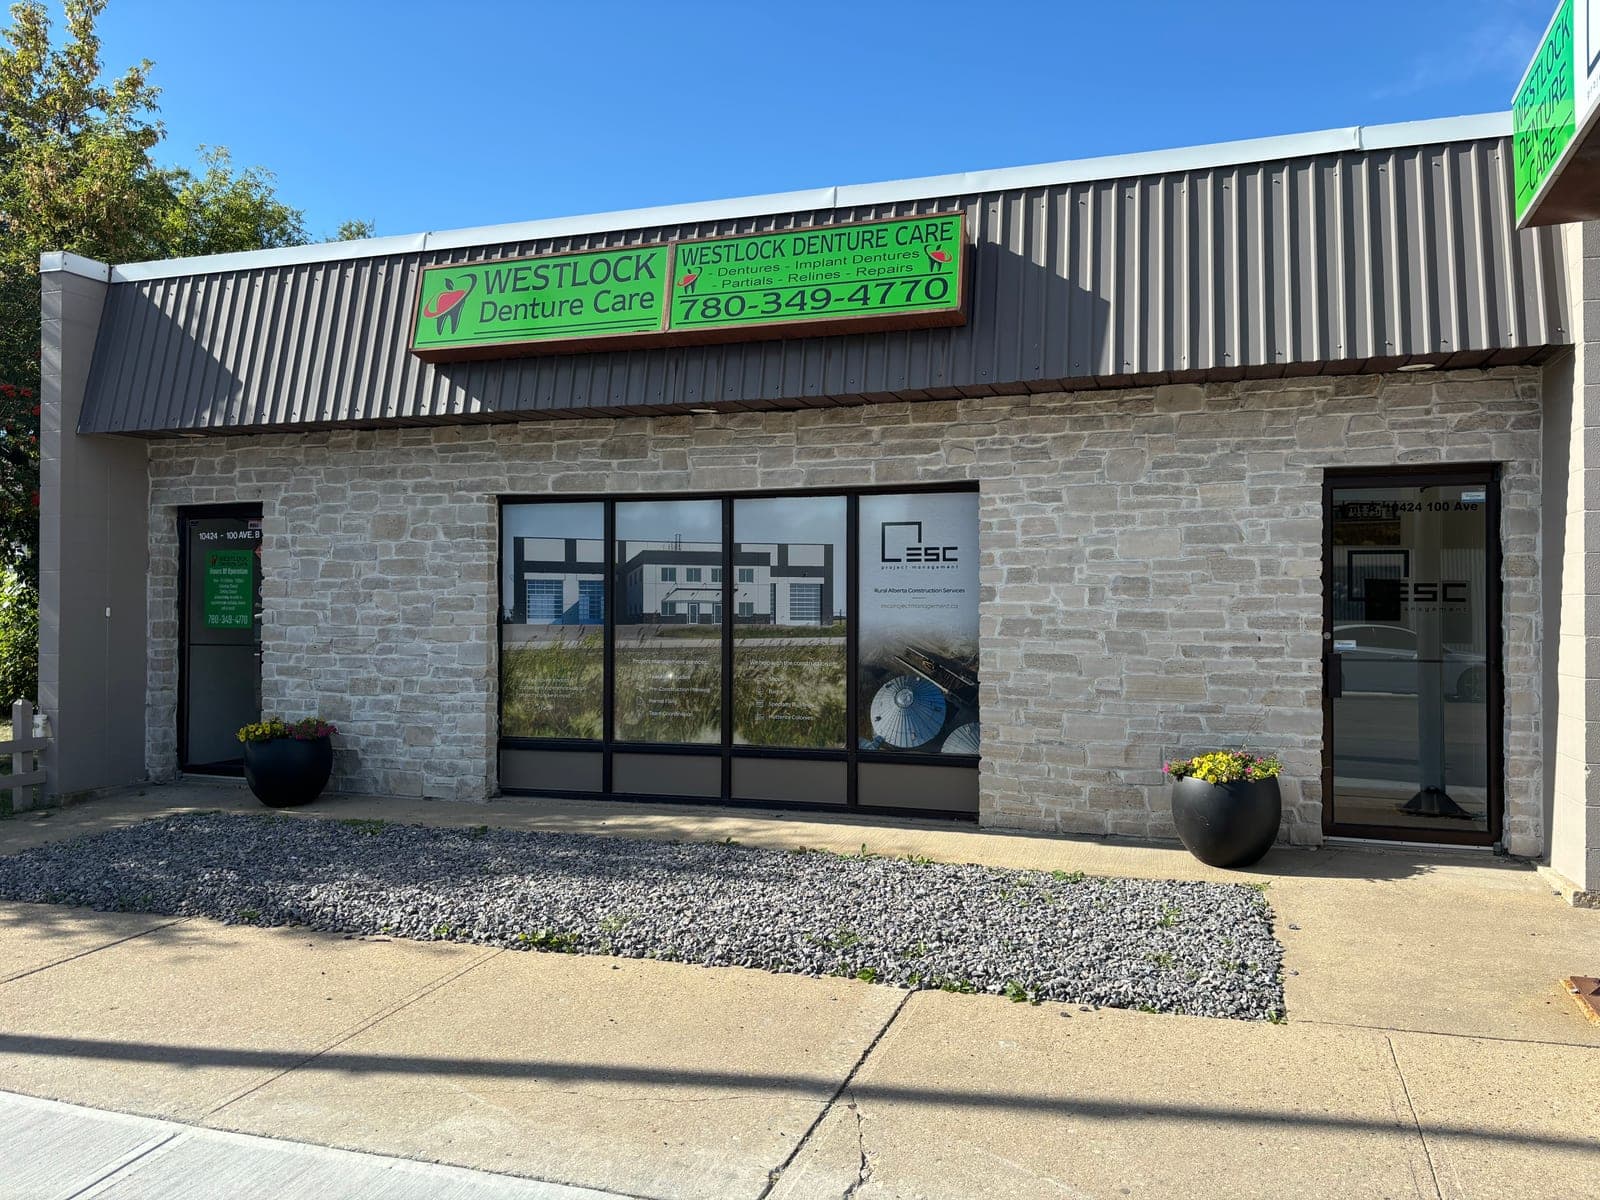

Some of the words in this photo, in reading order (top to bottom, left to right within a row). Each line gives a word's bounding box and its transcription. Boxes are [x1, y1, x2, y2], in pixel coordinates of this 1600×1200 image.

[1514, 6, 1570, 132] WESTLOCK
[1520, 61, 1567, 168] DENTURE
[1529, 125, 1557, 190] CARE
[681, 239, 787, 267] WESTLOCK
[793, 228, 889, 256] DENTURE
[895, 221, 954, 246] CARE
[484, 253, 657, 295] WESTLOCK
[718, 264, 780, 277] Dentures
[795, 256, 848, 270] Implant
[852, 250, 920, 264] Dentures
[722, 276, 774, 288] Partials
[788, 270, 841, 283] Relines
[856, 264, 914, 277] Repairs
[479, 297, 584, 323] Denture
[593, 290, 655, 313] Care
[680, 277, 949, 320] 780-349-4770
[1427, 502, 1449, 512] 100
[1454, 502, 1478, 512] Ave
[200, 531, 218, 540] 10424
[226, 531, 238, 540] 100
[208, 614, 249, 625] 780-349-4770
